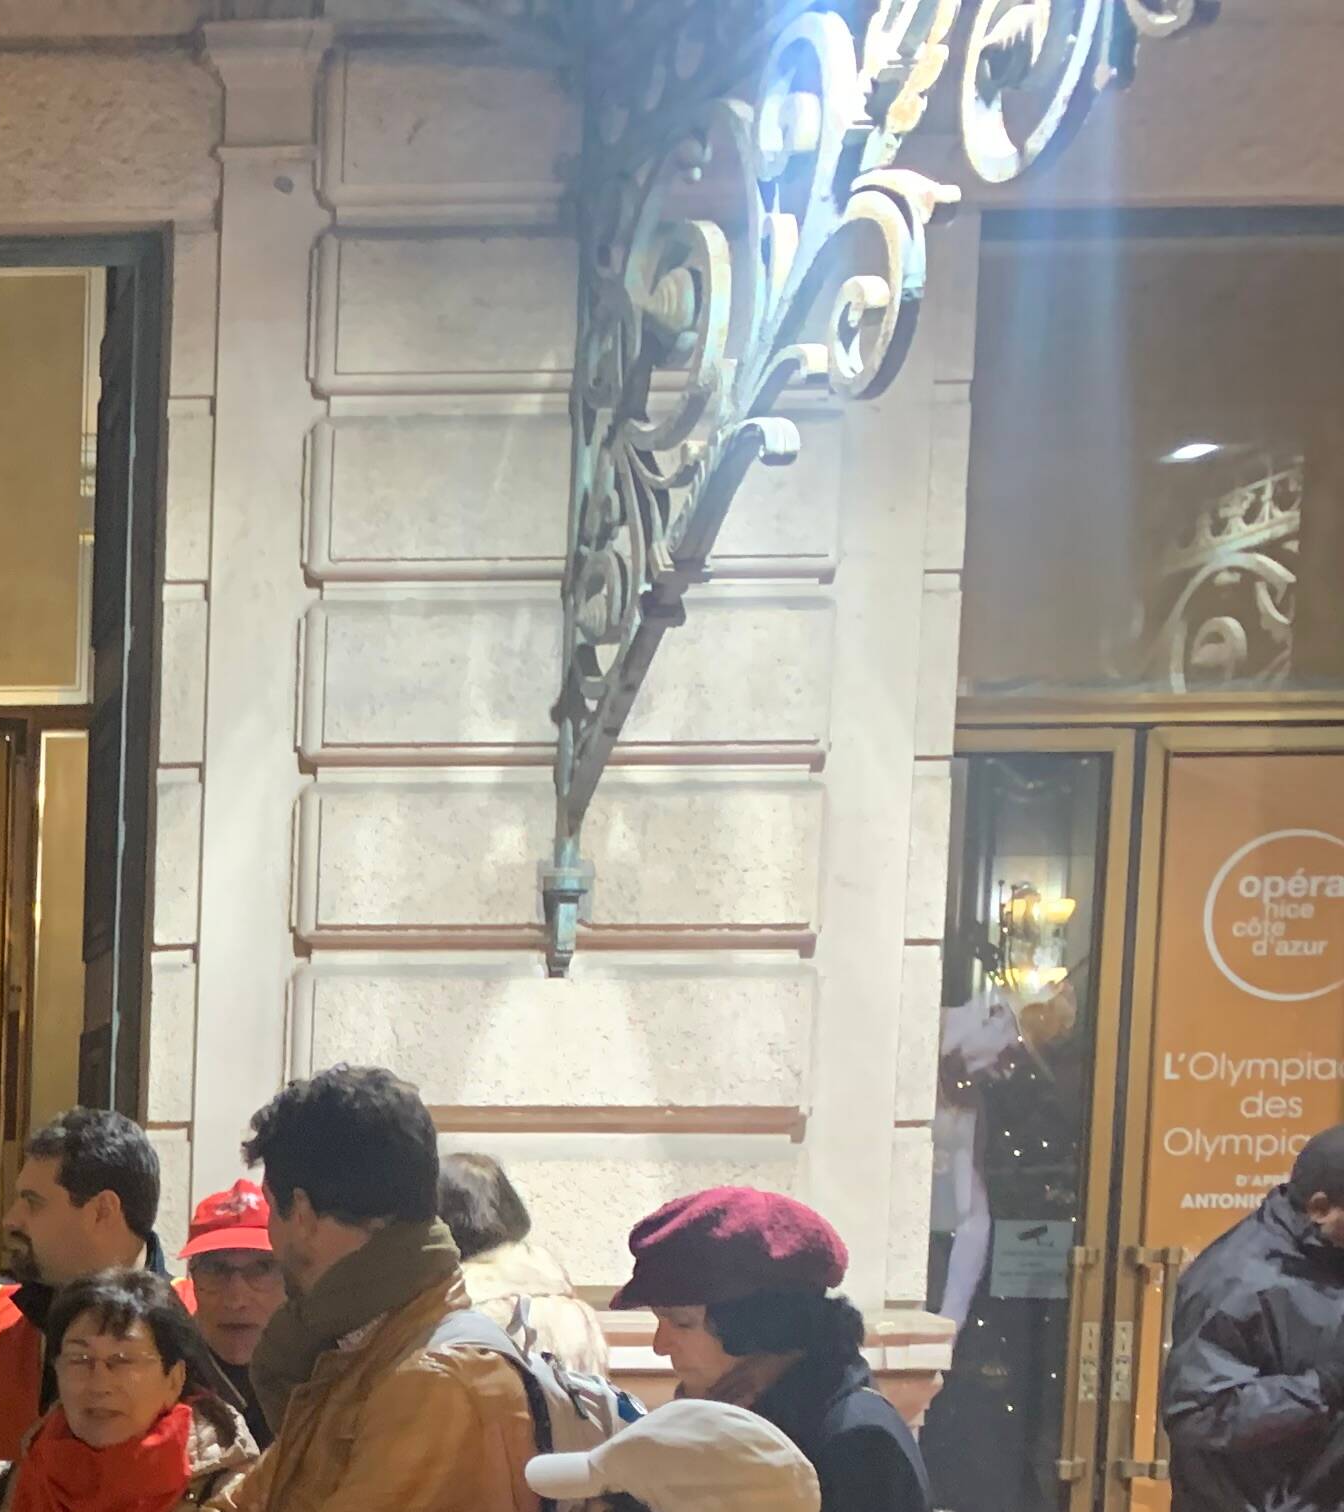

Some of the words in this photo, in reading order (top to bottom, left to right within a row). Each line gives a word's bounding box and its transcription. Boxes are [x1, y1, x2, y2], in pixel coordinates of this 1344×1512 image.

[1238, 867, 1344, 905] opéra
[1264, 899, 1315, 919] nice
[1252, 936, 1329, 956] d'azur
[1163, 1051, 1344, 1087] L'Olympia
[1240, 1089, 1304, 1119] des
